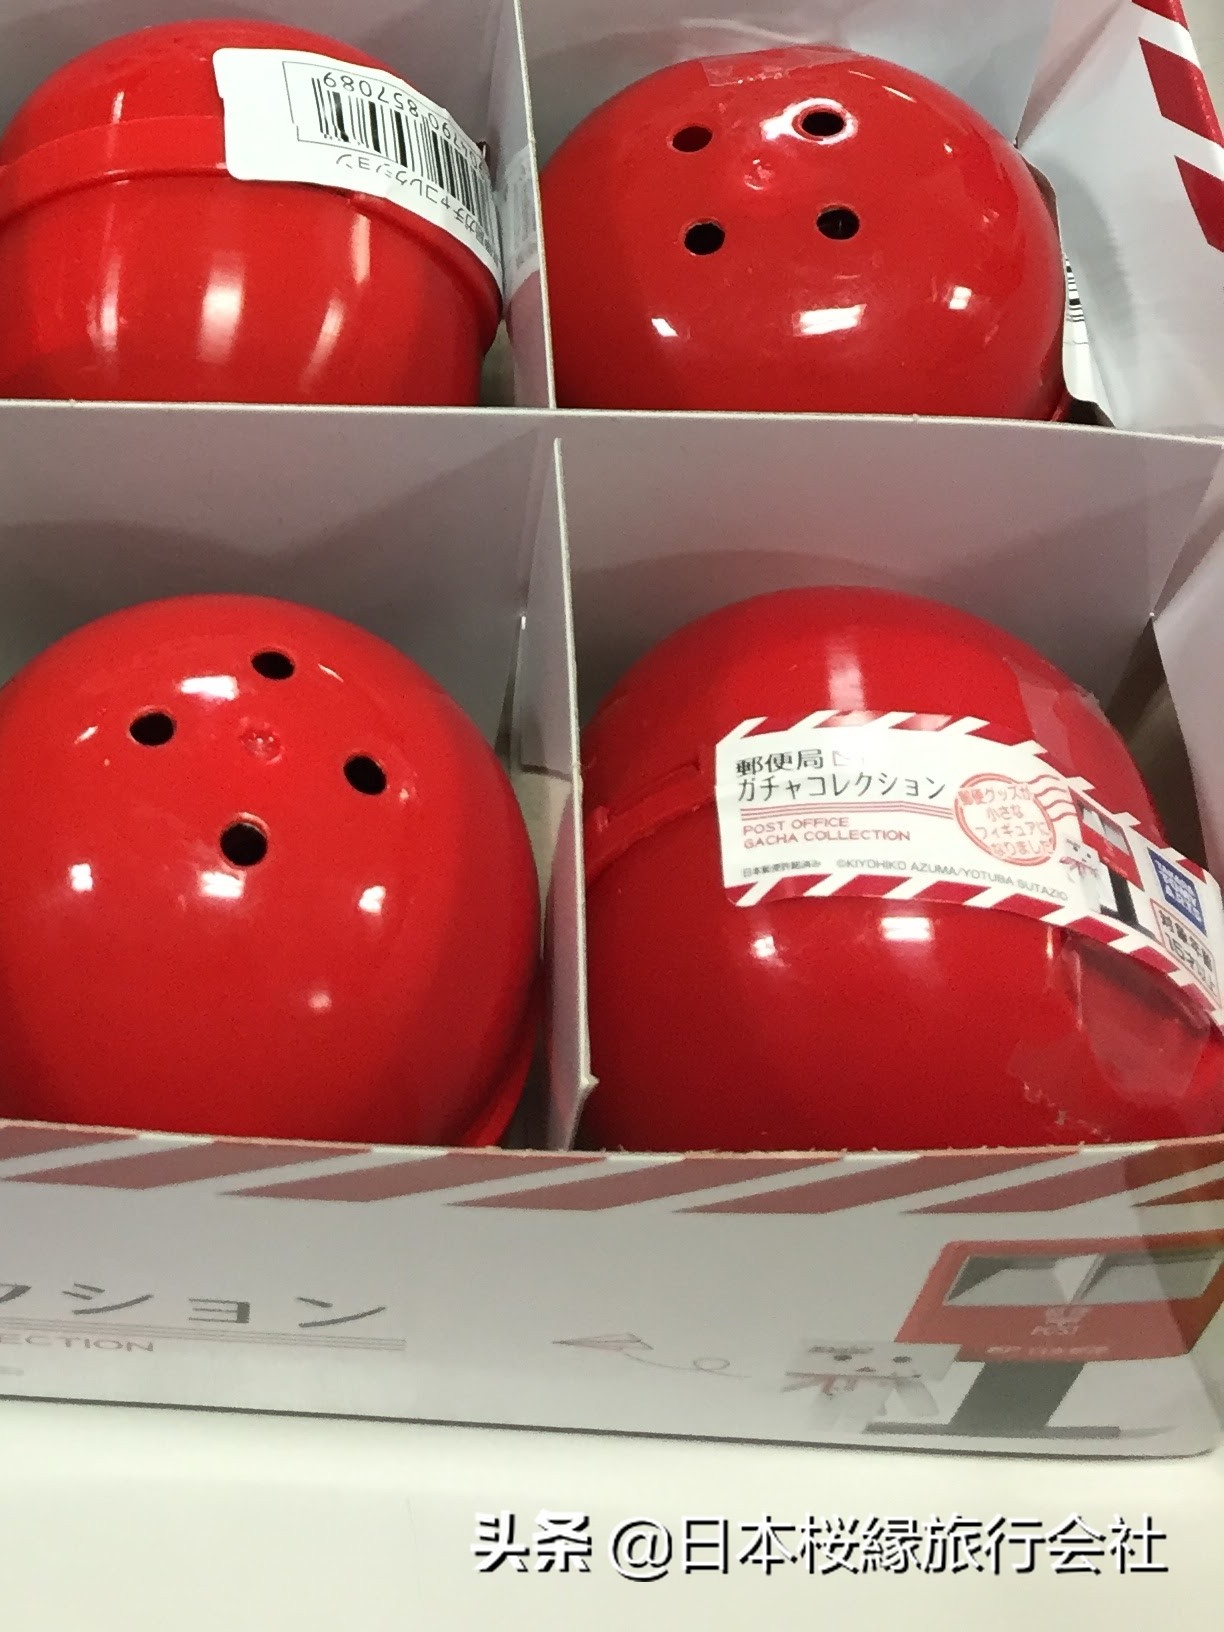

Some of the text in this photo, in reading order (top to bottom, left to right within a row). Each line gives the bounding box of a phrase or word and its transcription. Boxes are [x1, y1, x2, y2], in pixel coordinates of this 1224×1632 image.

[736, 748, 824, 778] 郵便局
[738, 772, 946, 802] ガチャコレクション
[743, 816, 850, 836] POST OFFICE
[744, 828, 911, 850] GACHA COLLECTION
